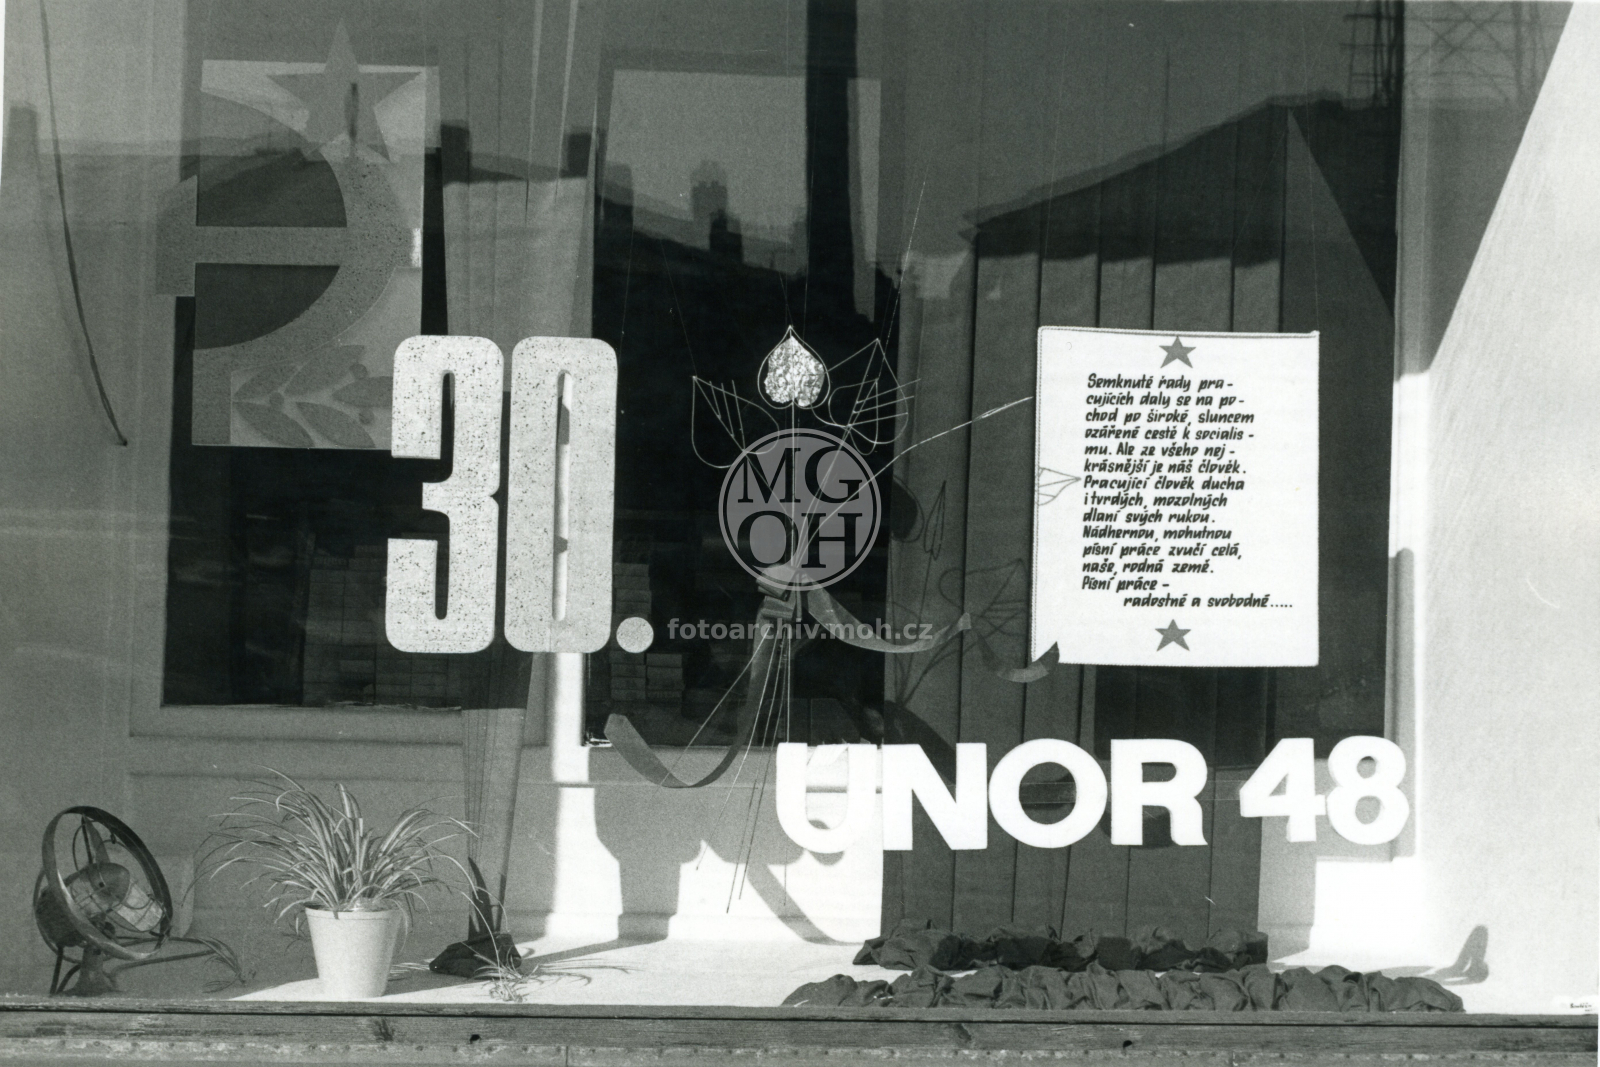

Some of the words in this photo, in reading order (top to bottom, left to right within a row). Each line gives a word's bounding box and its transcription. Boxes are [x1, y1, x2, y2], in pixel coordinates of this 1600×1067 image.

[1087, 372, 1154, 389] Semknuté
[1157, 374, 1192, 393] řady
[1085, 390, 1135, 408] cujících
[1139, 391, 1171, 409] daly
[1175, 395, 1192, 407] se
[1195, 395, 1214, 406] na
[1085, 407, 1119, 422] chod
[1123, 412, 1142, 426] po
[1146, 408, 1192, 429] široké,
[1197, 408, 1255, 424] sluncem
[1084, 424, 1141, 439] ozářené
[1144, 425, 1178, 440] cestě
[1182, 425, 1191, 440] k
[1084, 445, 1112, 456] mu.
[1115, 441, 1135, 456] Ale
[1139, 445, 1156, 457] ze
[1161, 441, 1199, 458] všeho
[1083, 457, 1151, 476] krásnější
[1149, 460, 1164, 477] je
[1167, 458, 1194, 474] náš
[1083, 474, 1150, 493] Pracující
[1154, 475, 1195, 491] člověk
[1201, 475, 1245, 491] ducha
[385, 334, 654, 654] 30.
[1090, 490, 1148, 510] tvrdých,
[1152, 492, 1228, 511] mozolných
[1082, 506, 1121, 523] dlaní
[1124, 508, 1164, 527] svých
[1082, 524, 1159, 543] Nádhernou,
[1162, 525, 1233, 540] mohutnou
[1082, 542, 1118, 558] písní
[1119, 542, 1161, 560] práce
[1168, 542, 1208, 557] zvučí
[1211, 542, 1242, 560] celá,
[1081, 557, 1118, 577] naše,
[1122, 557, 1165, 573] rodná
[1081, 575, 1115, 591] Písní
[1115, 576, 1158, 594] práce
[1123, 592, 1188, 608] radostné
[1190, 597, 1202, 608] a
[1239, 735, 1411, 846] 48
